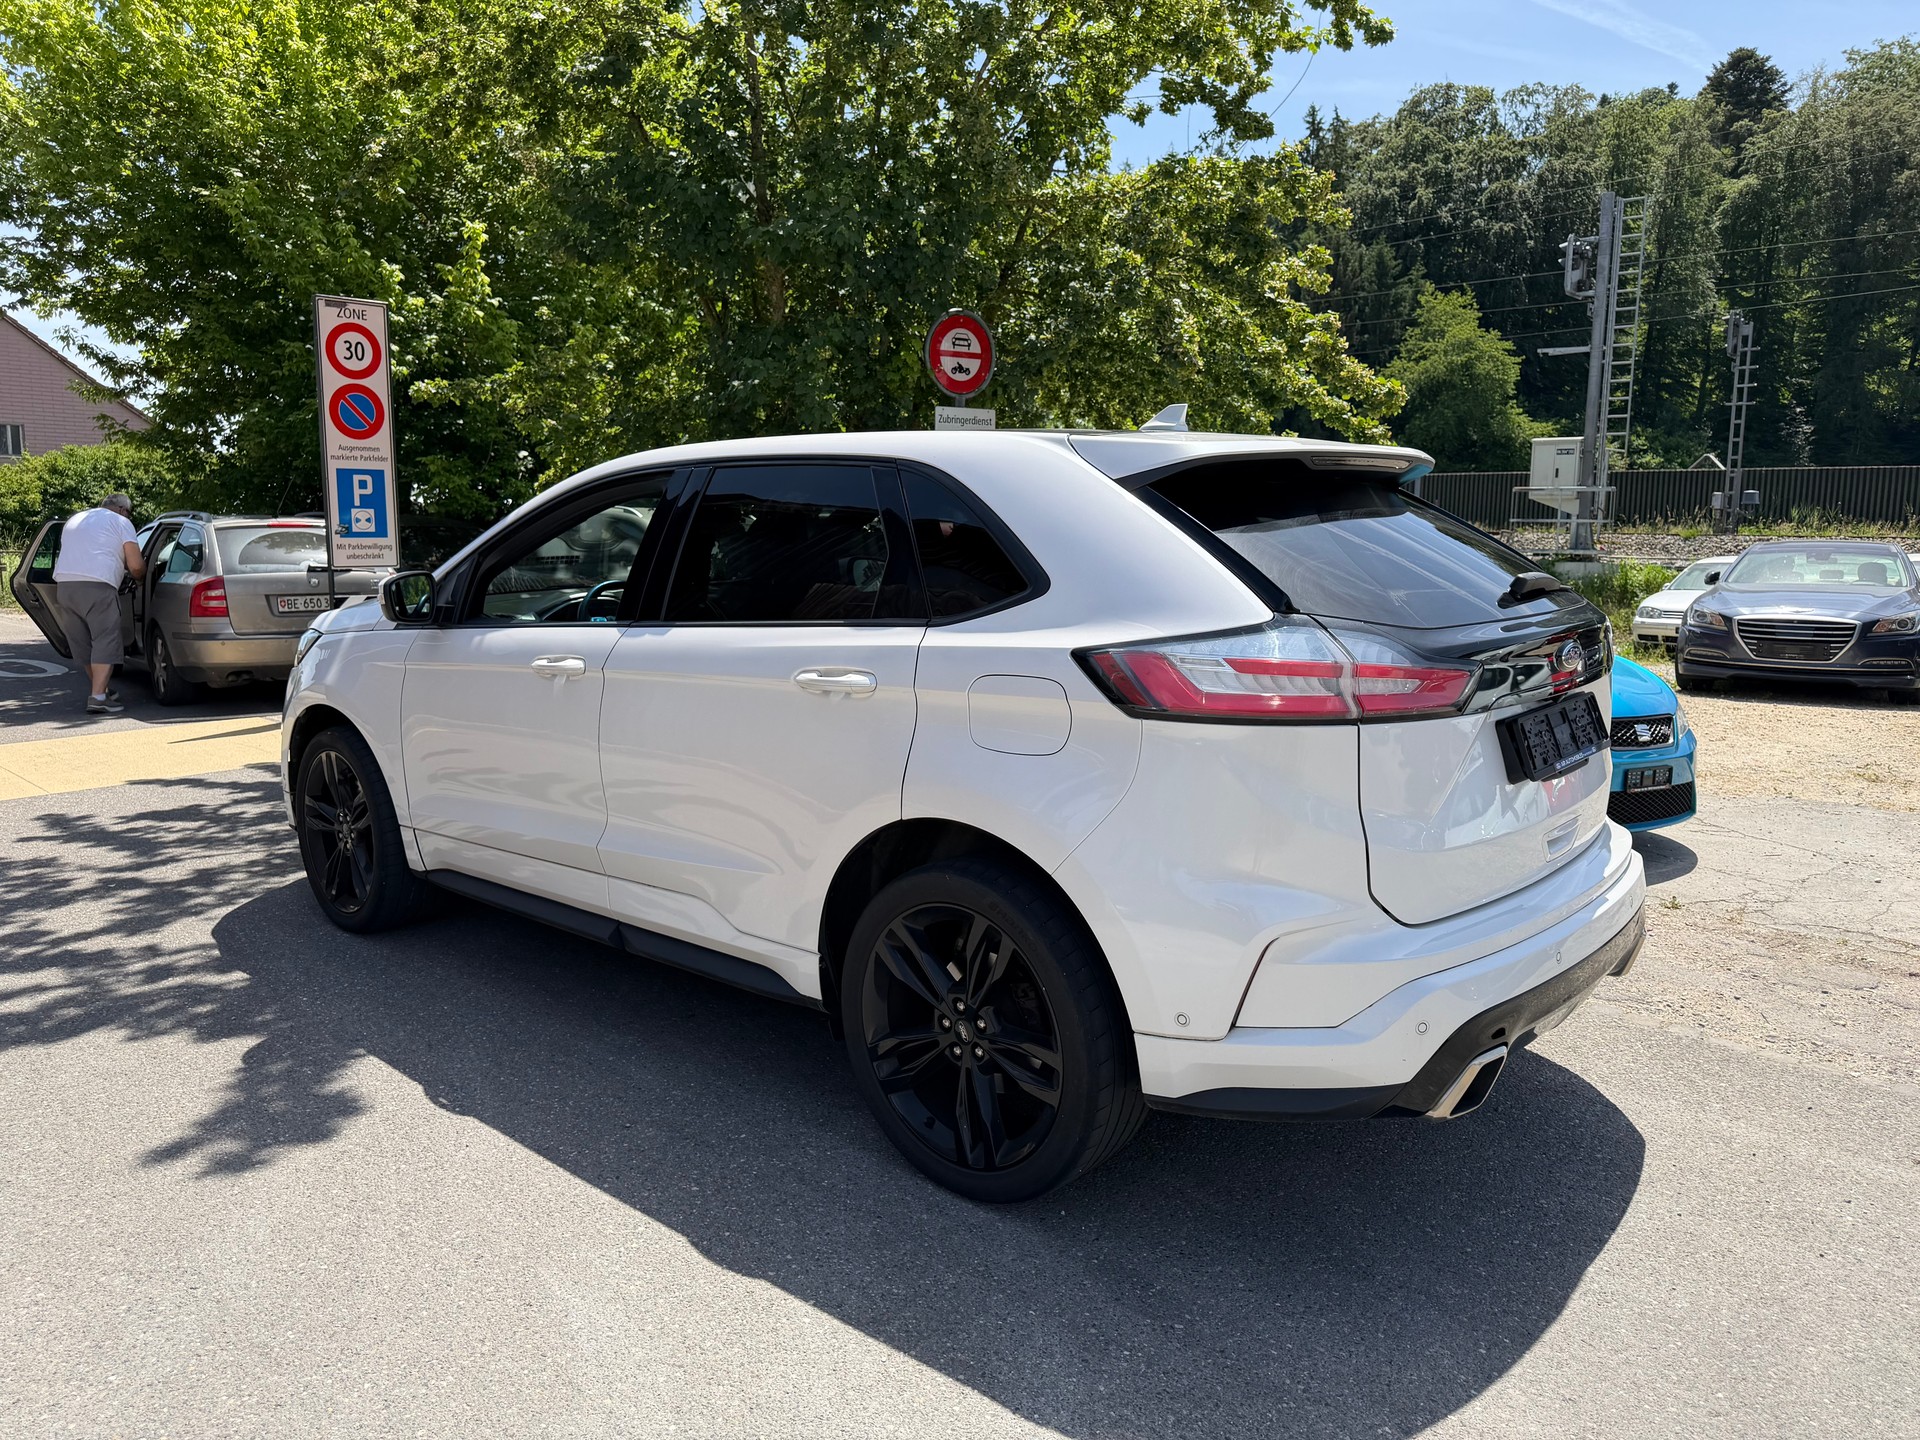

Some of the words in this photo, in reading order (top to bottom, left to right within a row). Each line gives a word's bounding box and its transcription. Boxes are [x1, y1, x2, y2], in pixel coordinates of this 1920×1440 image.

[337, 307, 367, 321] ZONE
[343, 340, 366, 362] 30
[938, 414, 992, 427] Zubringerdienst
[338, 444, 381, 453] Ausgenommen
[330, 454, 359, 462] markierte
[359, 454, 389, 463] Parkfelder
[352, 474, 374, 507] P
[348, 543, 393, 552] Parkbewilligung
[346, 552, 384, 560] unbeschränkt
